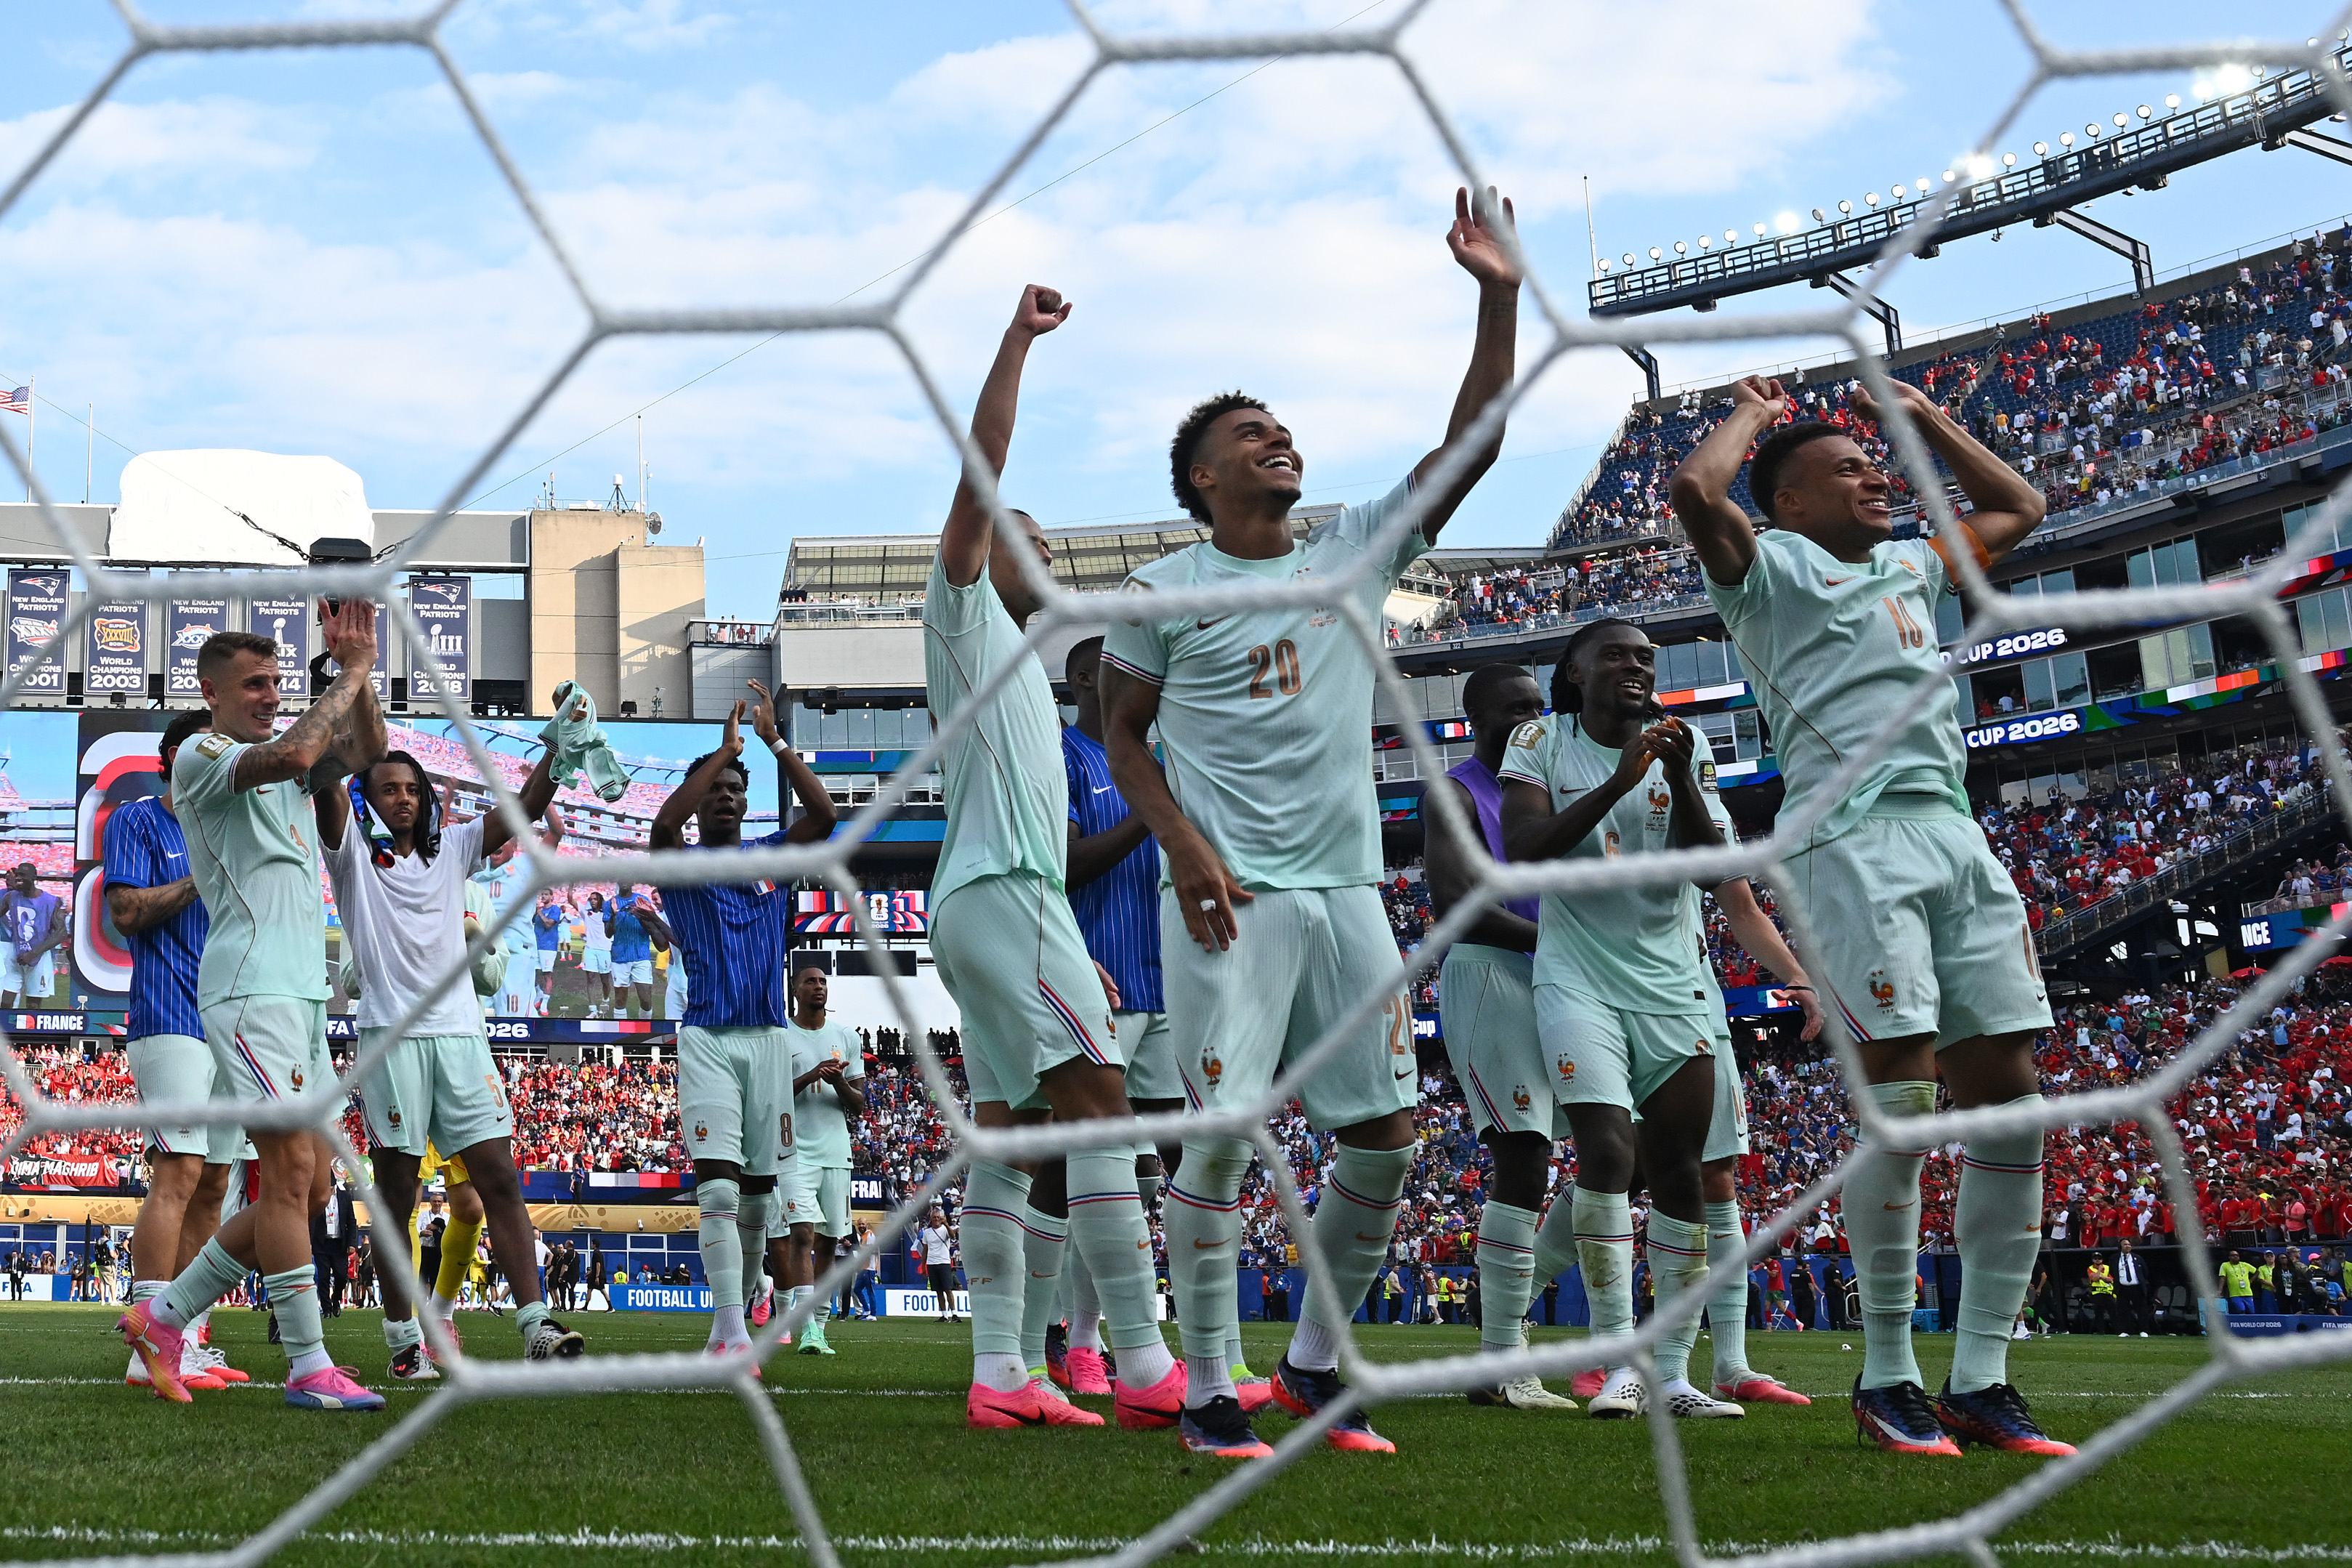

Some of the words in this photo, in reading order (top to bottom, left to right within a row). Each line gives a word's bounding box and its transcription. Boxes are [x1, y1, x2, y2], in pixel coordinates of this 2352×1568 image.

[100, 626, 134, 644] XXXVIII
[1996, 628, 2066, 656] 2026
[90, 666, 142, 674] CHAMPIONS
[100, 656, 133, 666] WORLD
[1248, 638, 1302, 700] 20
[90, 674, 141, 688] 2003
[1966, 727, 2005, 748] CUP
[2008, 713, 2077, 741] 2026
[36, 1014, 84, 1030] FRANCE
[485, 1022, 528, 1038] 026
[1412, 1018, 1436, 1038] Cup
[484, 1074, 504, 1108] 5
[780, 1112, 793, 1147] 8
[43, 1161, 100, 1177] MAGHRIB
[851, 1180, 882, 1199] FRA
[628, 1289, 695, 1308] FOOTBALL
[903, 1294, 971, 1312] FOOTLL
